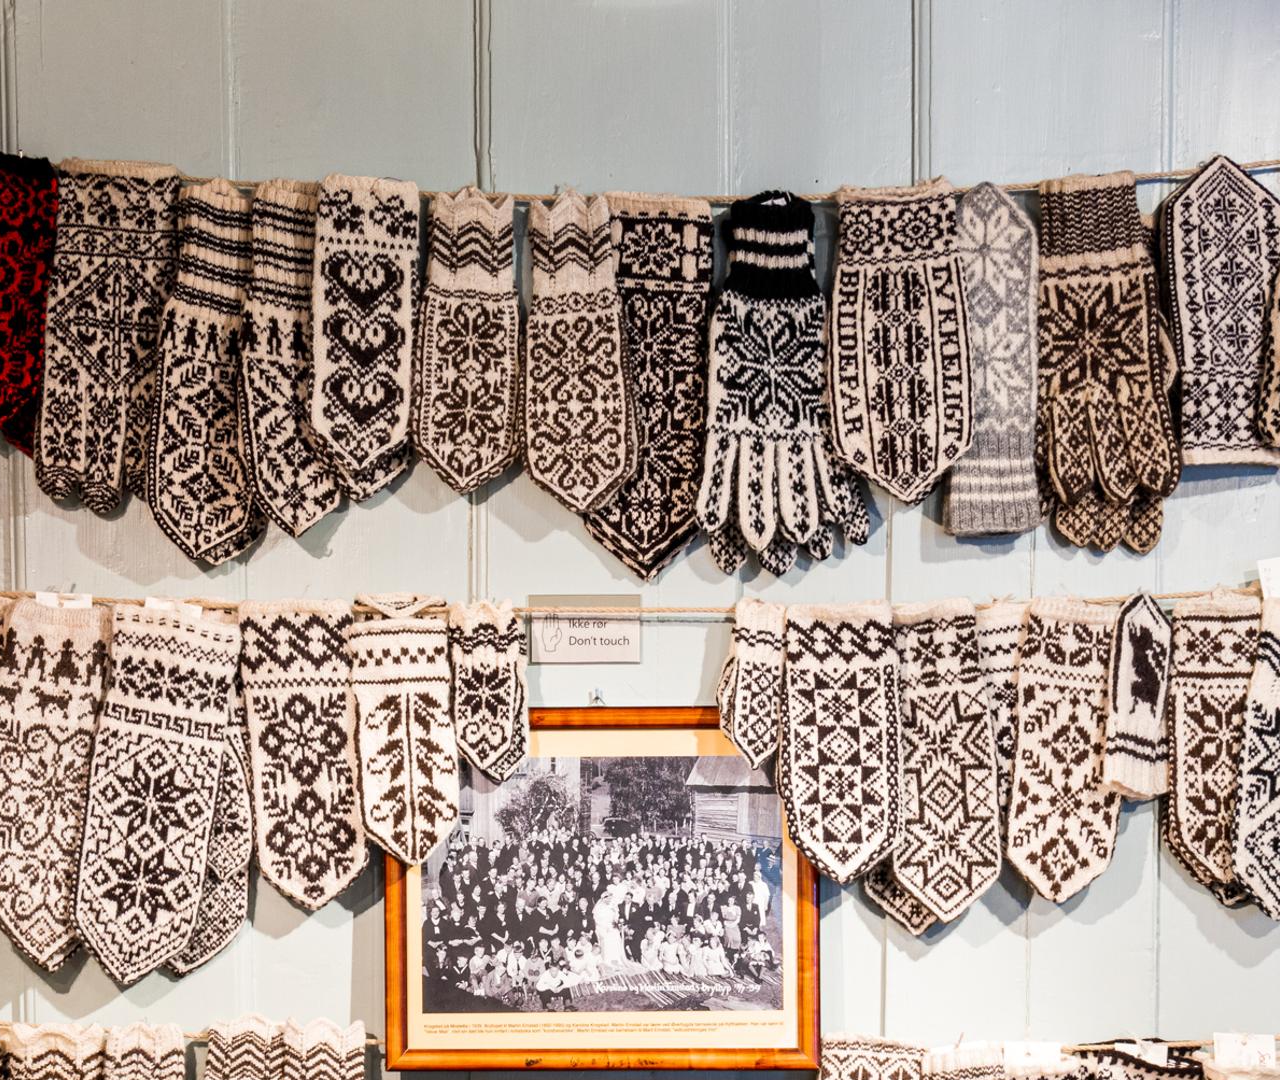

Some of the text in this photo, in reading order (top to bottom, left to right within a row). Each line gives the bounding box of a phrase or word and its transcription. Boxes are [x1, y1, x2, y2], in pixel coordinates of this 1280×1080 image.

[838, 269, 864, 437] BRUDEPAR
[932, 262, 964, 441] LYKKELIGT
[569, 618, 608, 628] Ikke rør
[569, 635, 630, 646] Don't touch
